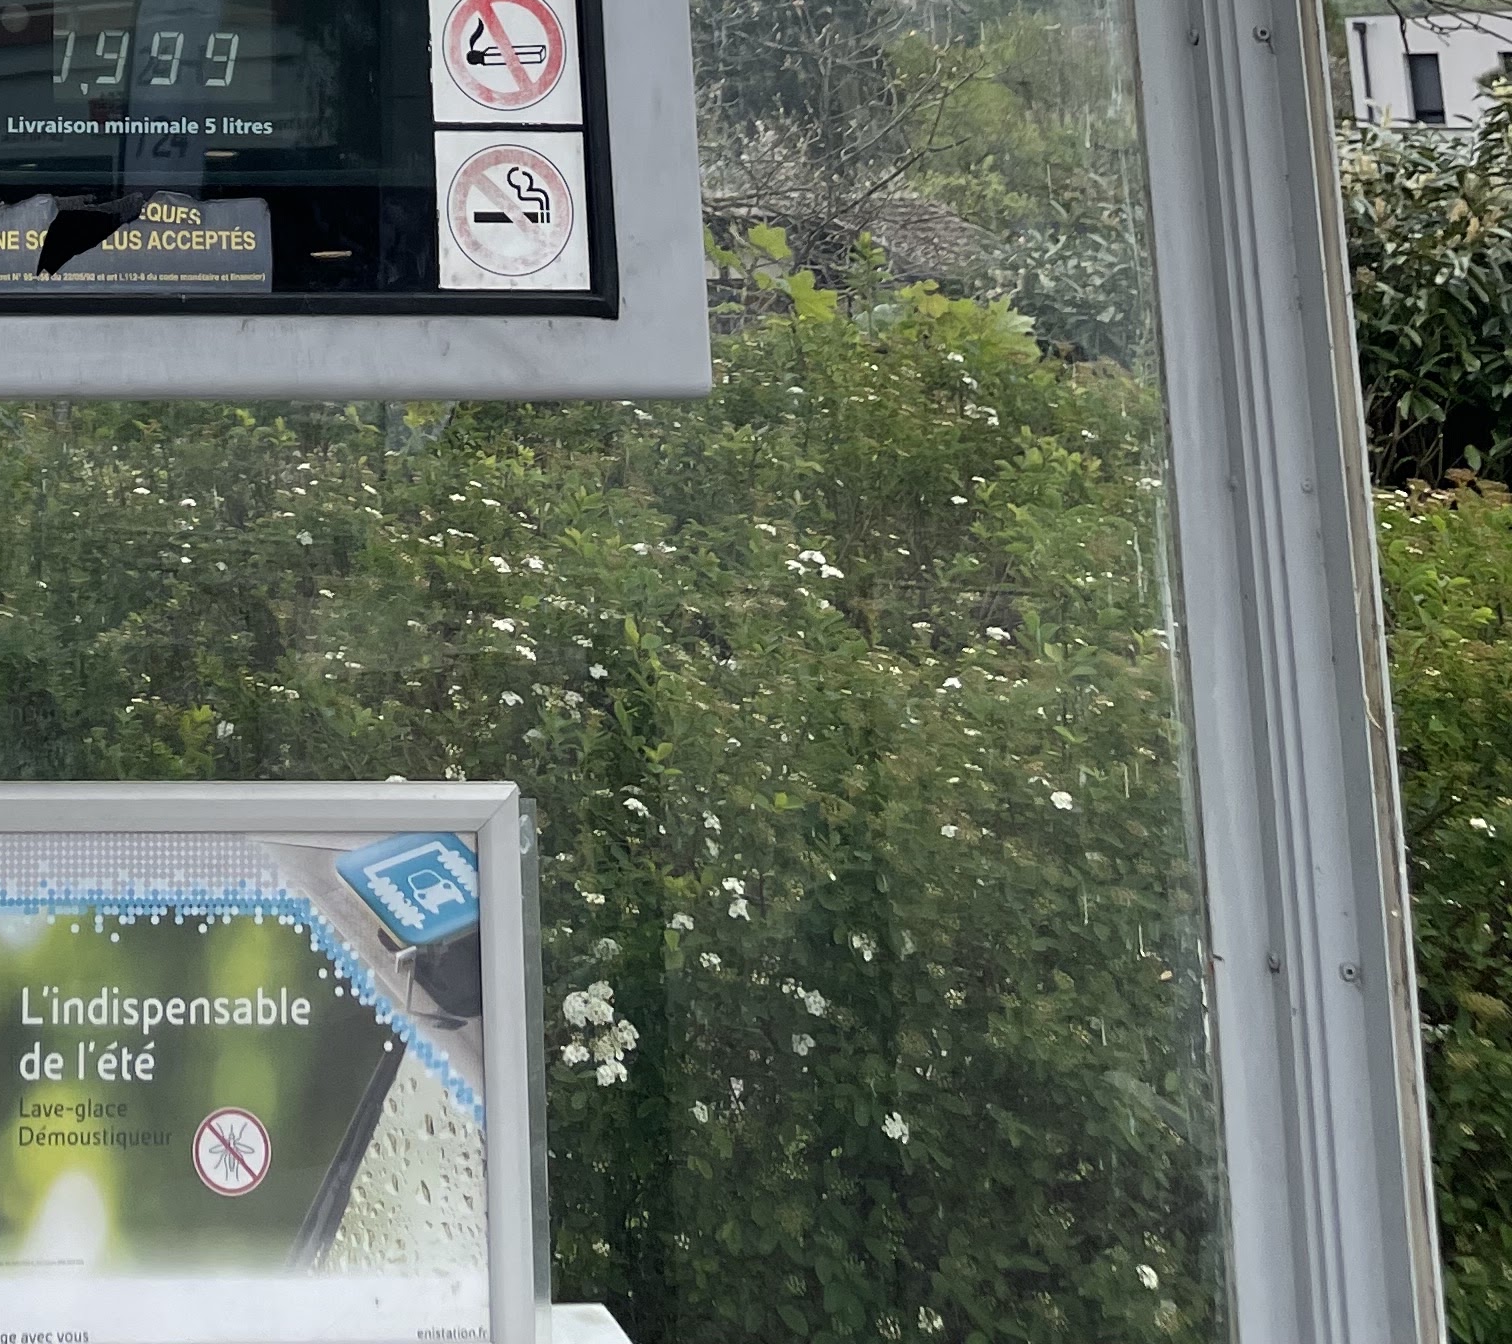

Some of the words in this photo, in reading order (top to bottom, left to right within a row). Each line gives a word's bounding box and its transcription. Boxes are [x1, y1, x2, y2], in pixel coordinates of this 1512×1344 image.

[7, 116, 100, 134] Livraison
[104, 116, 200, 135] minimale
[205, 118, 217, 135] 5
[222, 117, 273, 135] litres
[102, 230, 142, 250] LUS
[146, 227, 256, 250] ACCEPTÉS
[21, 986, 311, 1035] L'indispensable
[19, 1042, 64, 1081] de
[78, 1040, 155, 1081] l'été
[19, 1098, 128, 1122] Lave-glace
[18, 1124, 172, 1148] Démoustiqueur
[20, 1332, 52, 1344] avec
[56, 1331, 89, 1344] vous
[417, 1326, 488, 1340] enistation.fr
